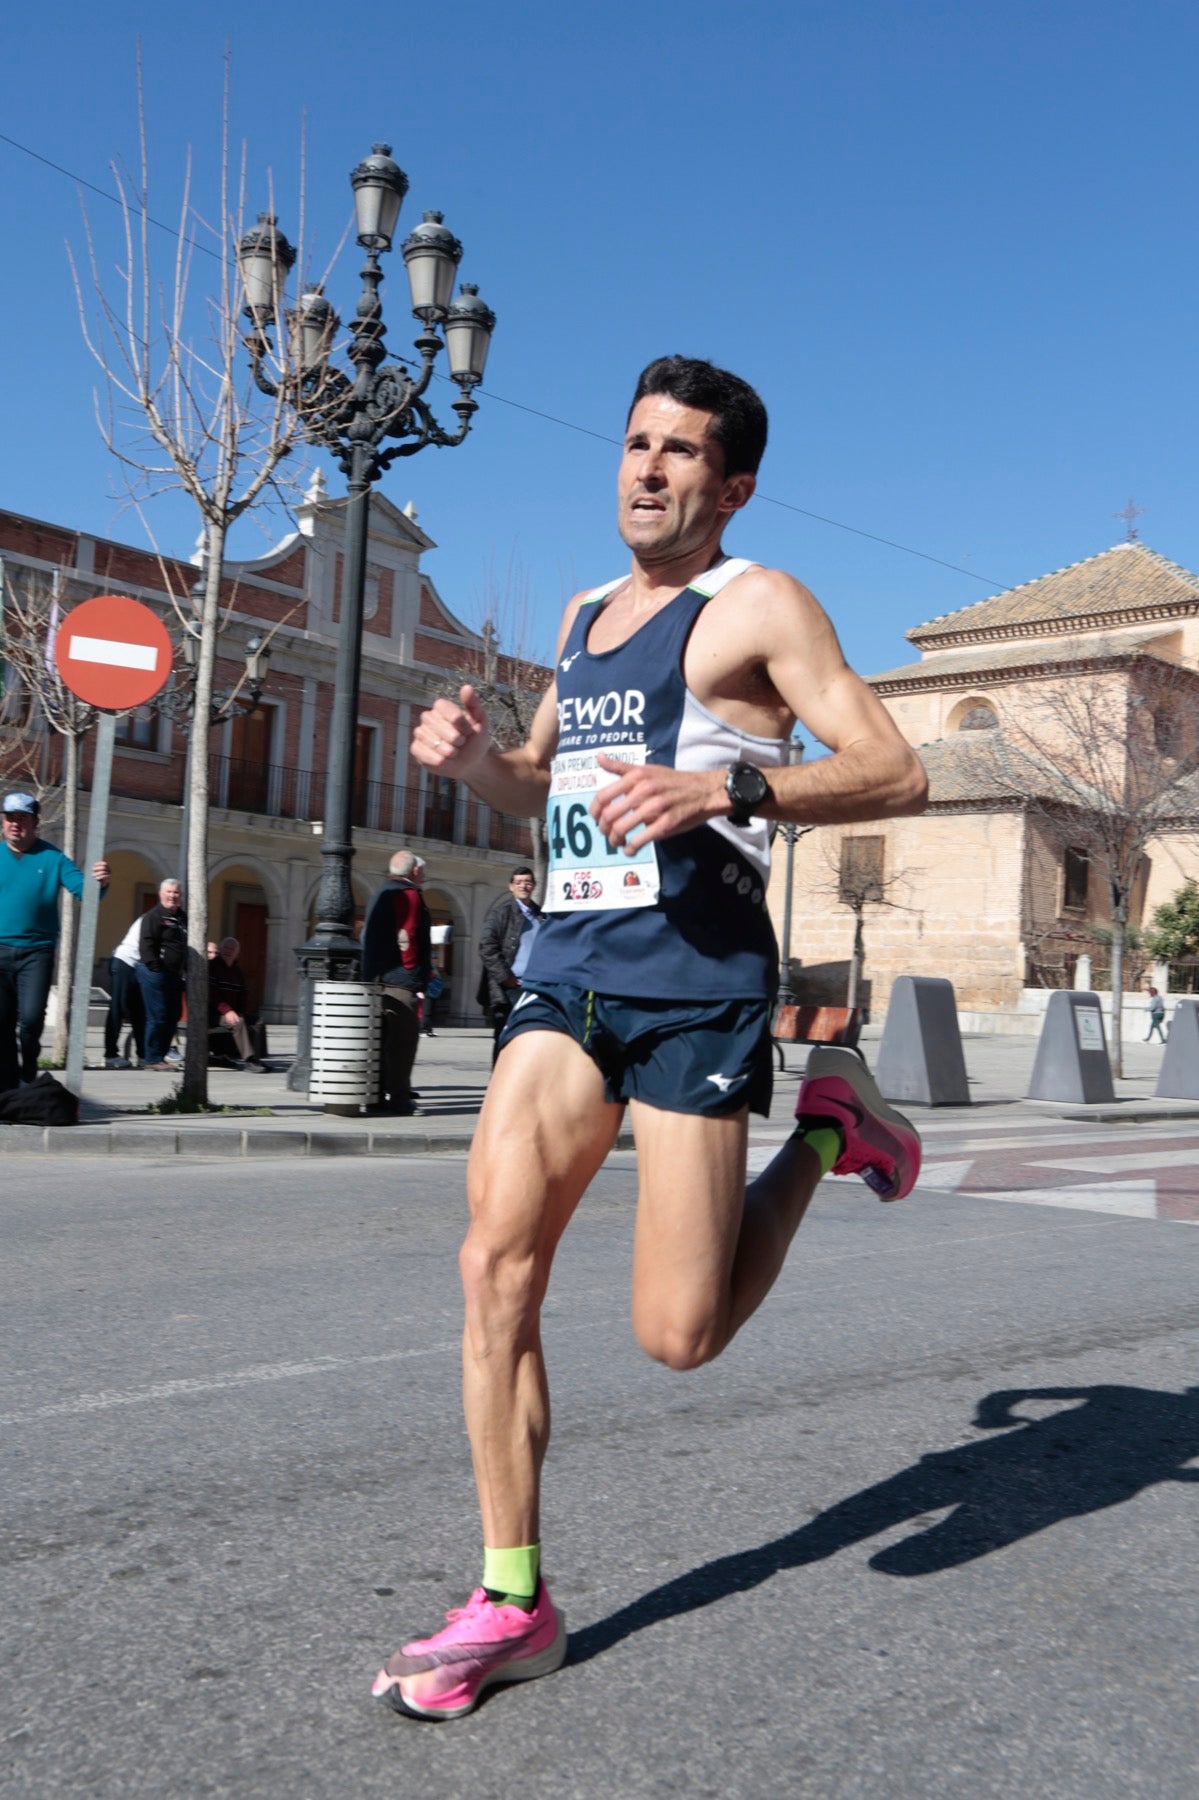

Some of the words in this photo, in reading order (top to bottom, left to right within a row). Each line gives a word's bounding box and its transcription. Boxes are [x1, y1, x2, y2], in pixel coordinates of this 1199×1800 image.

[585, 734, 597, 744] TO
[600, 732, 644, 743] PEOPLE
[568, 757, 593, 773] PREMIO
